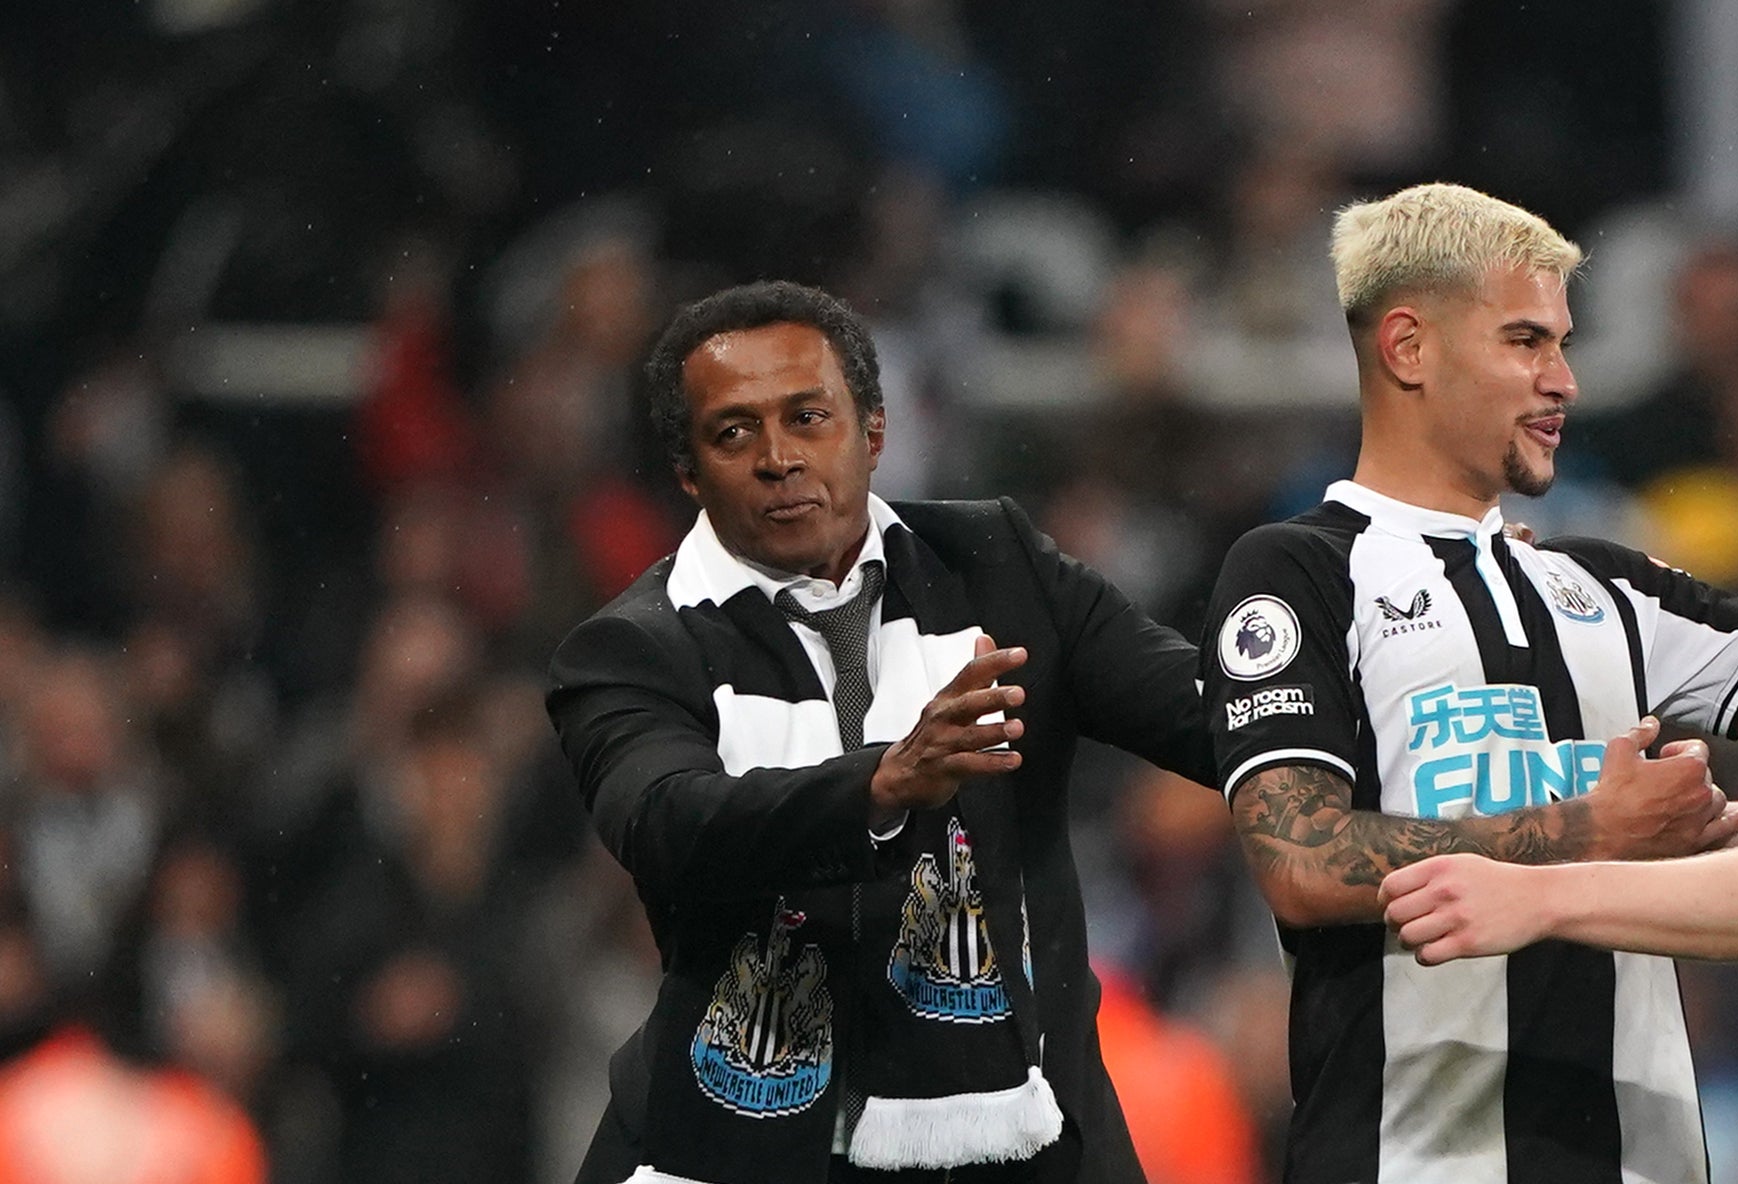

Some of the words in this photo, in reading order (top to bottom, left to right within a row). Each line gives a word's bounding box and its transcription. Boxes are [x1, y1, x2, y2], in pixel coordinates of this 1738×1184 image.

[1382, 620, 1442, 639] CASTORE
[1225, 697, 1252, 716] No
[1252, 688, 1304, 707] room
[1227, 710, 1252, 731] for
[1252, 700, 1315, 721] racism
[1408, 684, 1545, 751] 乐天堂
